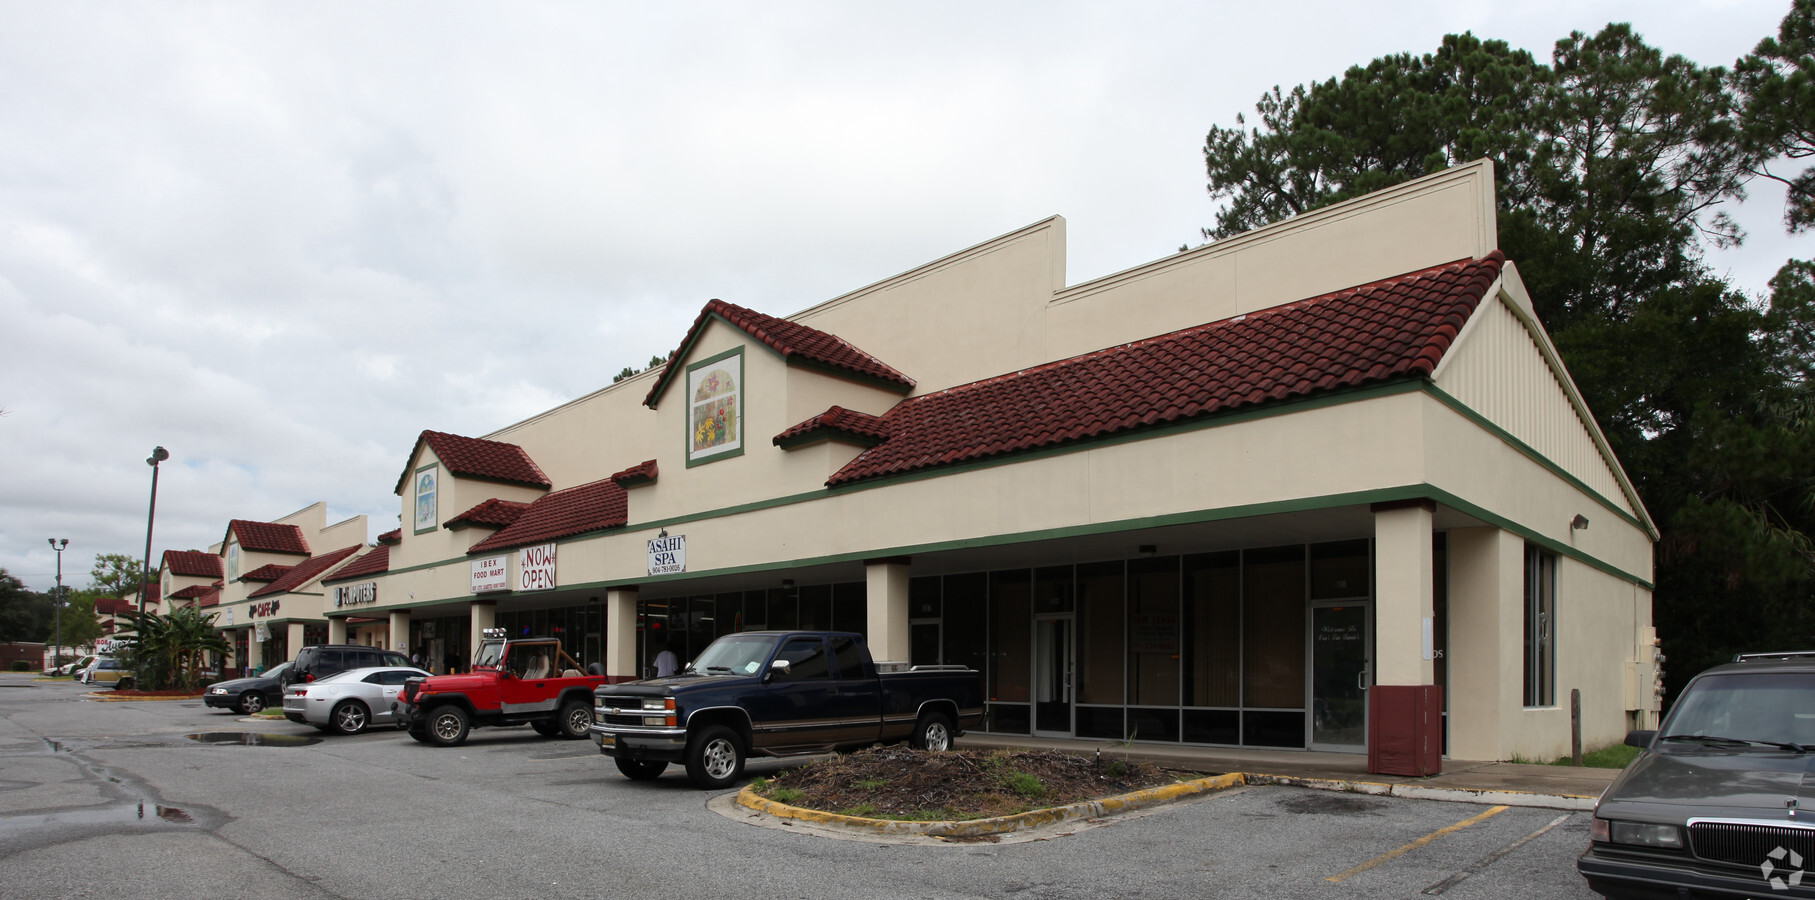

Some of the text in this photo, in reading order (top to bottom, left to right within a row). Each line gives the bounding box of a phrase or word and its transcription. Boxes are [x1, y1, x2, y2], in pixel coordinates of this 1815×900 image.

[649, 537, 681, 554] ASAHI
[480, 559, 497, 568] IBEX
[526, 543, 552, 568] NOW
[655, 552, 676, 566] SPA
[473, 568, 505, 579] FOOD MART
[523, 567, 553, 589] OPEN
[257, 601, 271, 618] CAFE
